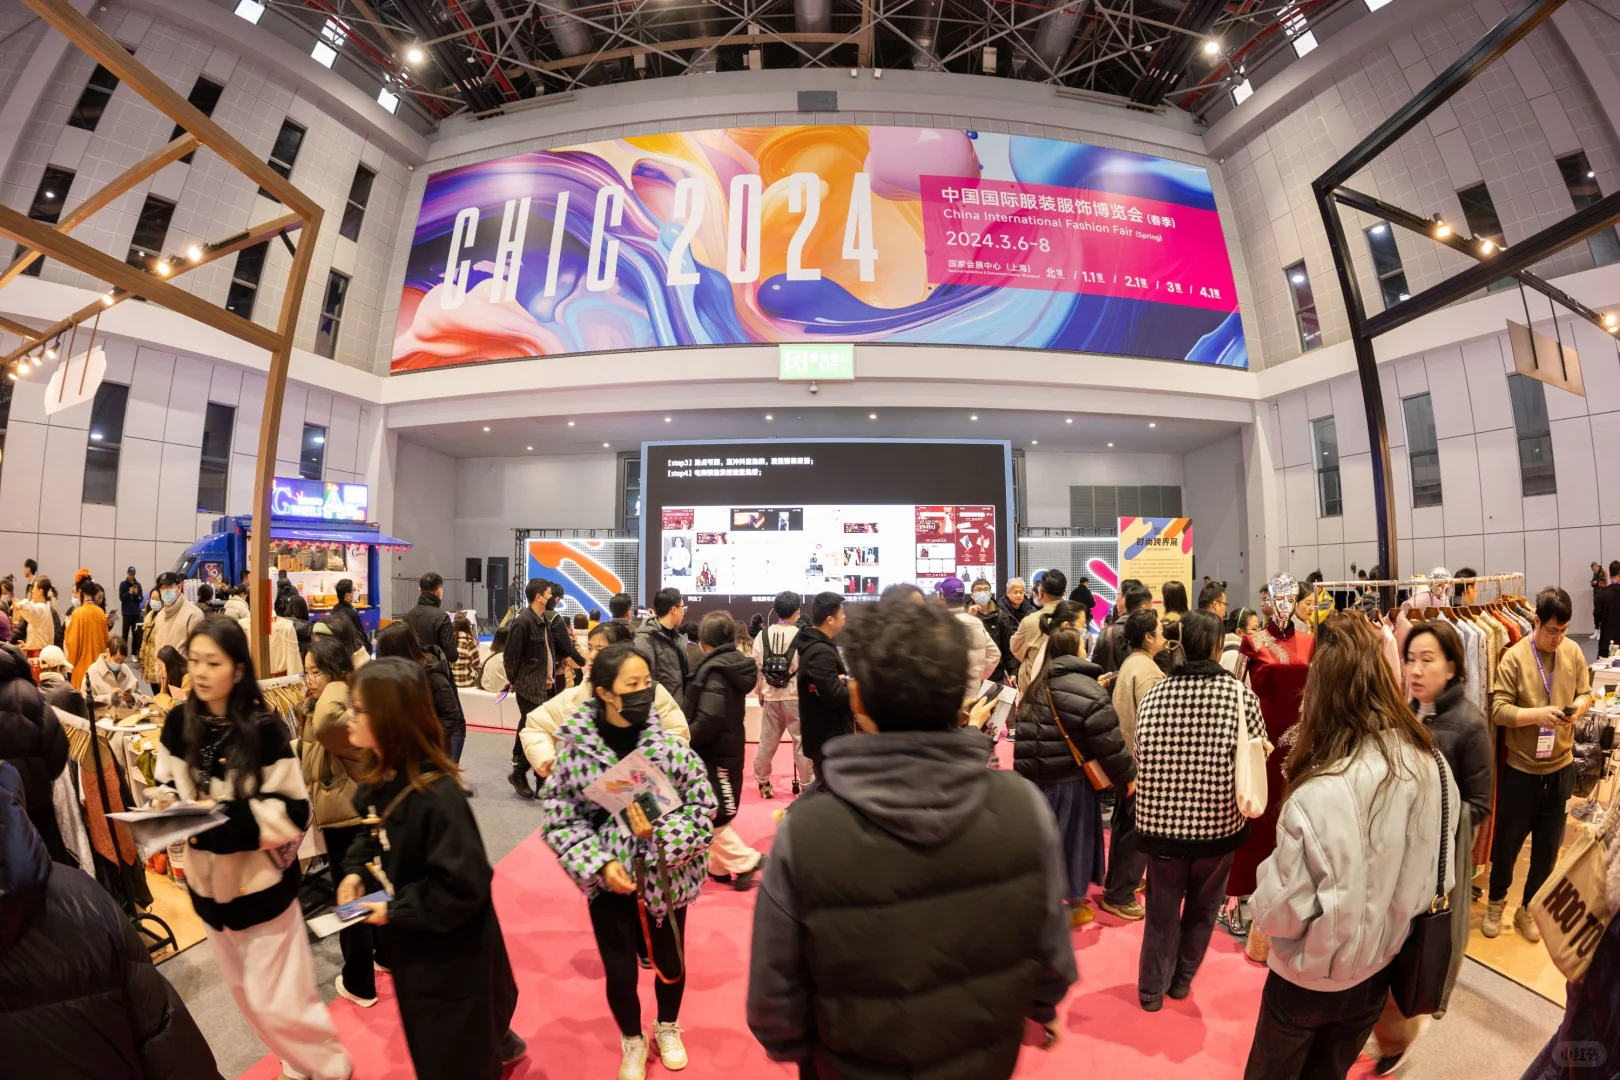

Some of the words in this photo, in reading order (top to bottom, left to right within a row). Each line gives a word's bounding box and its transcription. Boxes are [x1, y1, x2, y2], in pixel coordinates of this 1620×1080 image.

[941, 187, 1144, 224] 中国国际服装服饰博览会
[440, 184, 625, 311] CHIC
[667, 172, 879, 287] 2024
[943, 208, 980, 221] China
[984, 211, 1063, 228] International
[1065, 219, 1110, 234] Fashion
[1112, 224, 1134, 237] Fair
[1135, 229, 1163, 243] (Spring)
[945, 230, 1051, 253] 2024.3.6-8
[1136, 537, 1179, 546] 时尚跨界展
